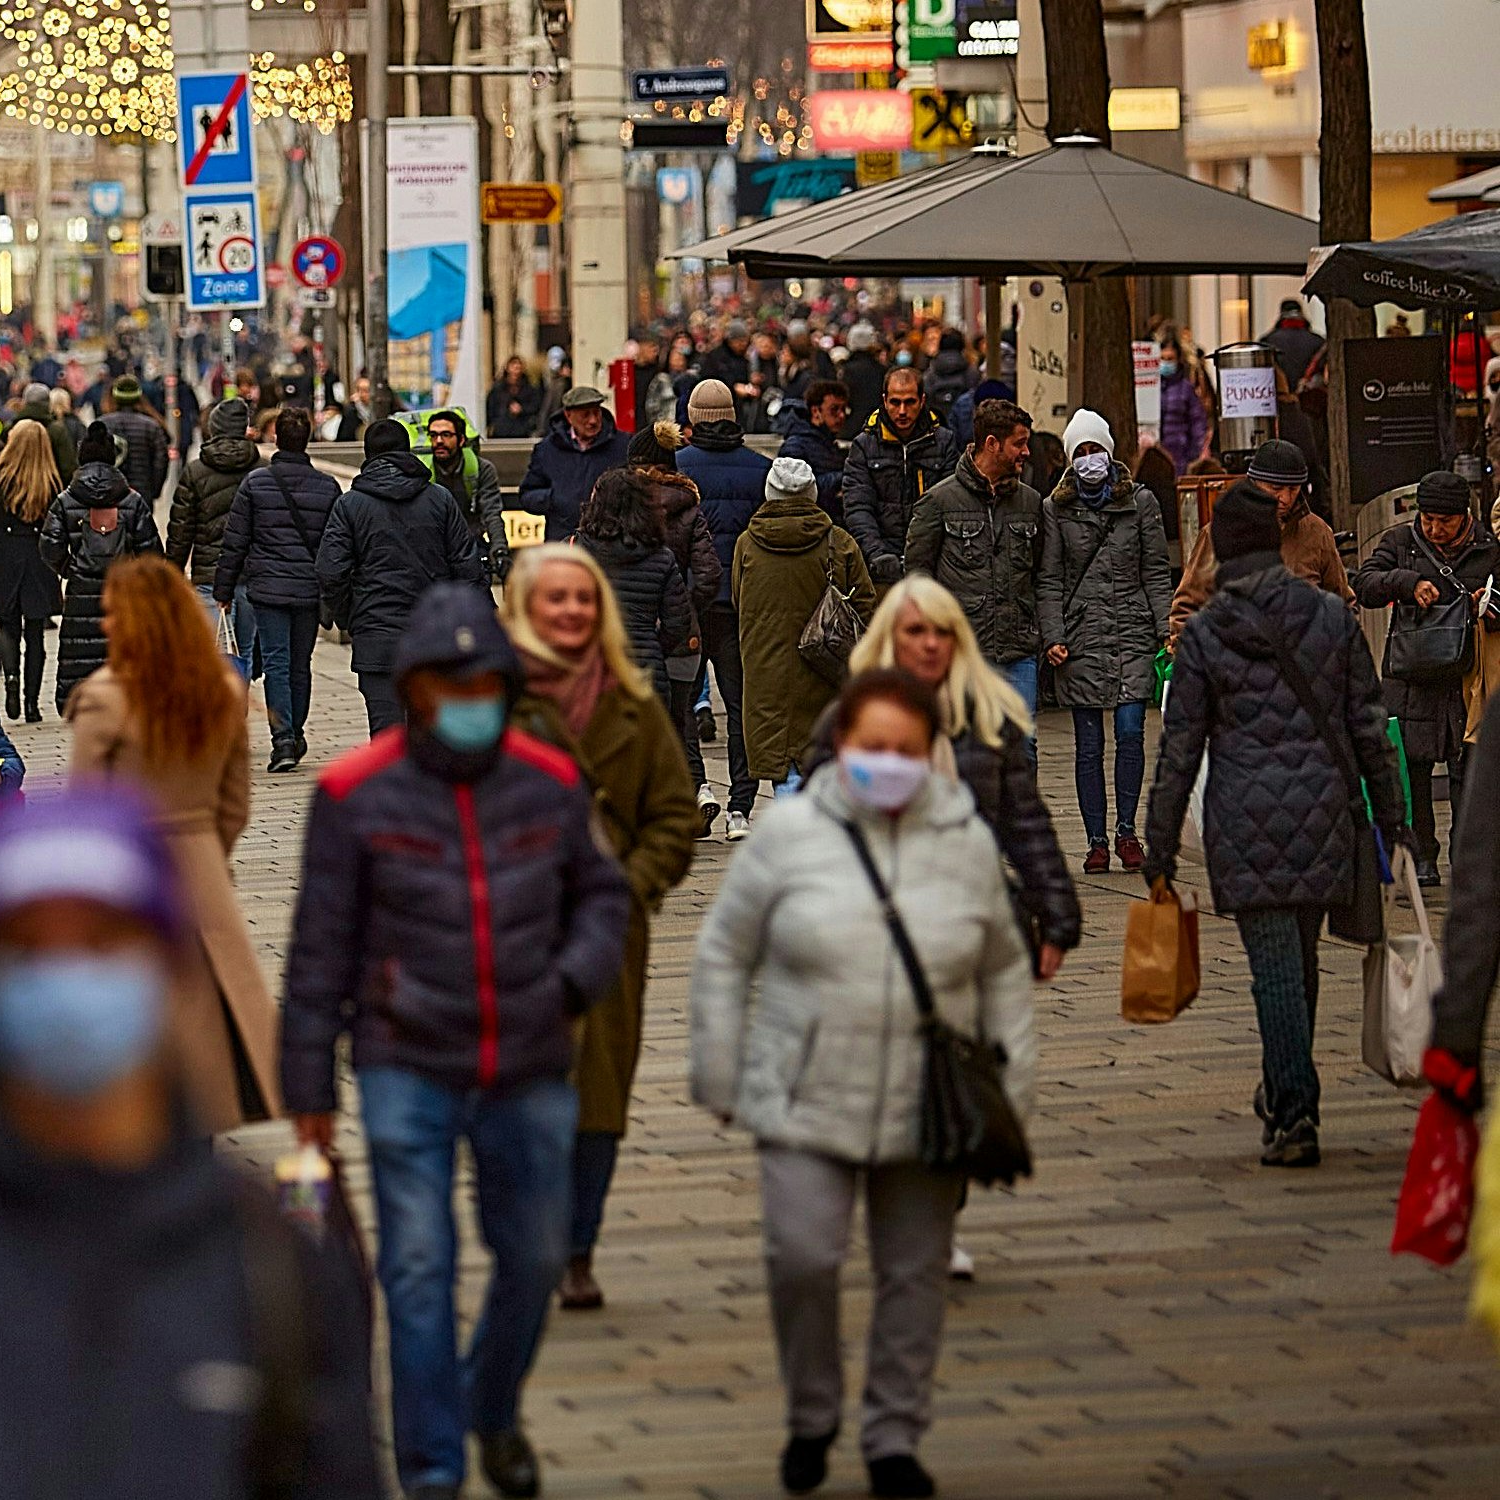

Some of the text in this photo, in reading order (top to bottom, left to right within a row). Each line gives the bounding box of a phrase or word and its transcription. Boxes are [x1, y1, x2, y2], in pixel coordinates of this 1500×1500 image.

[1373, 123, 1500, 153] colatiers
[200, 277, 250, 298] Zone
[1226, 386, 1276, 401] PUNSCH
